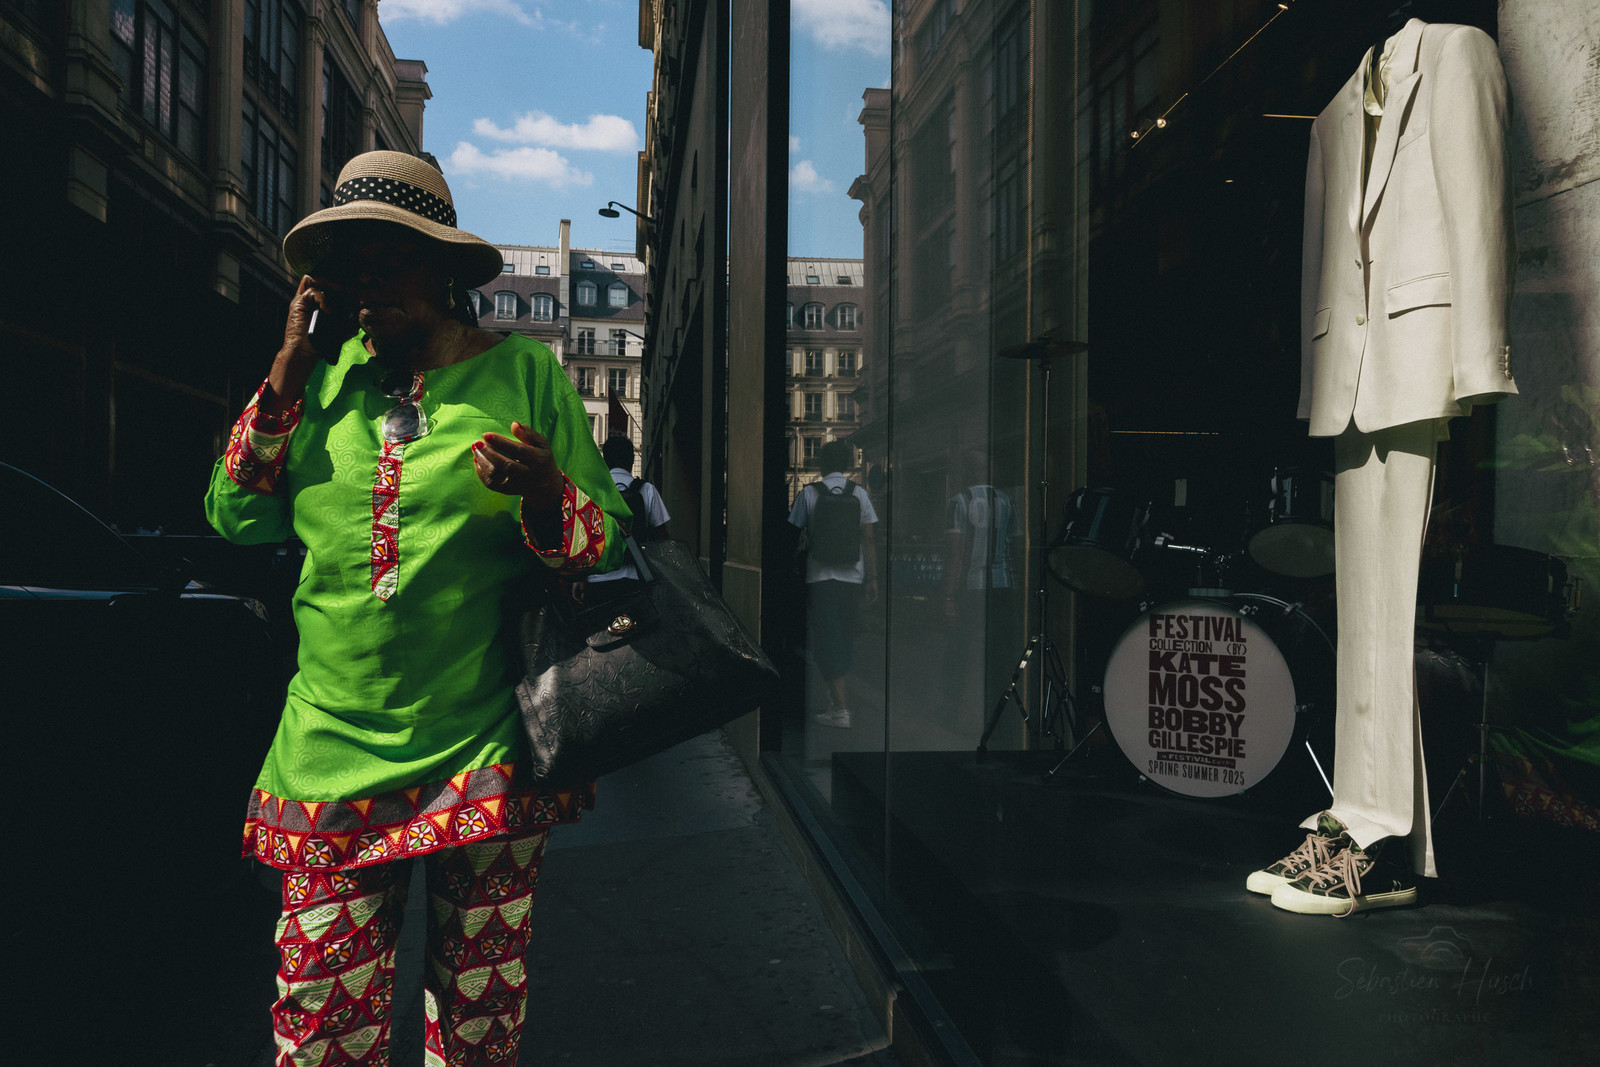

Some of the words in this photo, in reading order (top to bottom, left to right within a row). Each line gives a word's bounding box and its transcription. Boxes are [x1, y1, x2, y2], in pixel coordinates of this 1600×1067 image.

[1150, 614, 1246, 643] FESTIVAL
[1150, 638, 1213, 653] COLLECTION
[1226, 643, 1247, 655] (BY)
[1149, 650, 1246, 678] KATE
[1148, 671, 1246, 713] MOSS
[1148, 706, 1245, 738] BOBBY
[1148, 729, 1246, 758] GILLESPIE
[1168, 753, 1211, 764] FESTIVAL
[1148, 760, 1179, 777] SPRING
[1182, 764, 1219, 782] SUMMER
[1223, 769, 1245, 786] 2025
